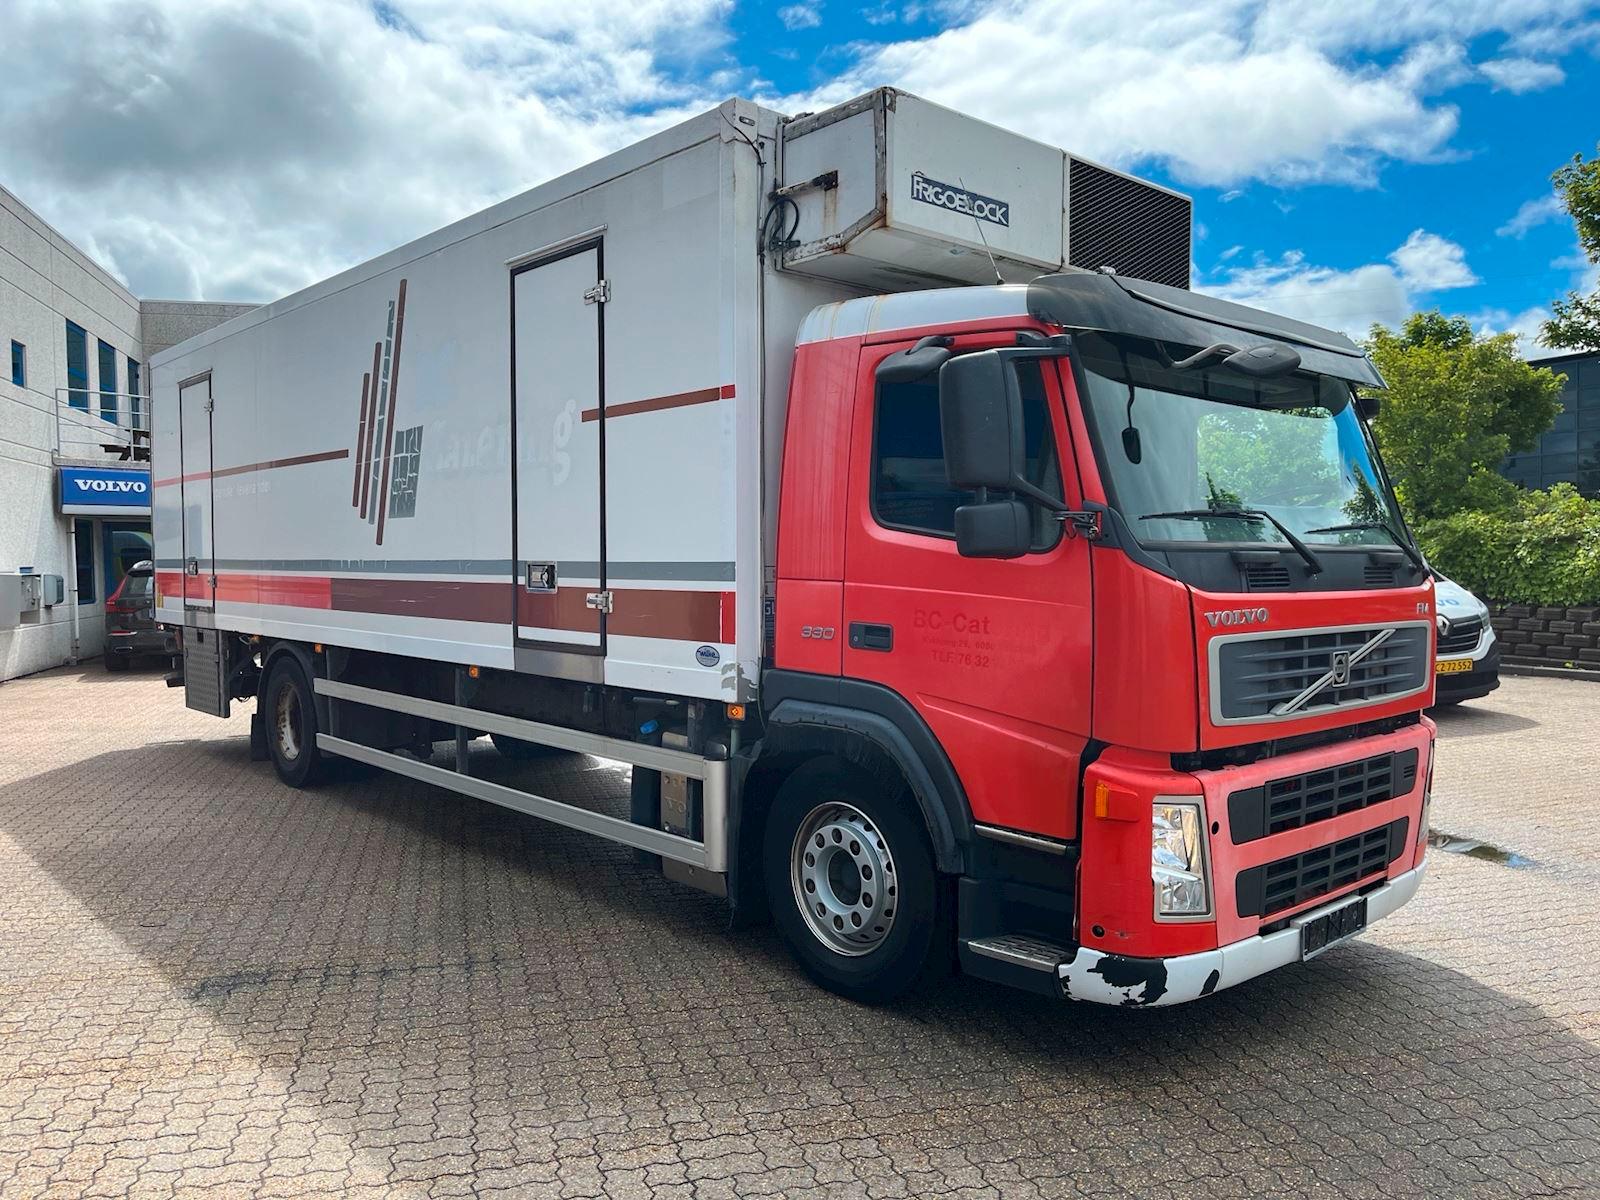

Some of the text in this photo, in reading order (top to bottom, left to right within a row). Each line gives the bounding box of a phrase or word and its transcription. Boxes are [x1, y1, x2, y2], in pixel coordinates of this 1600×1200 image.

[74, 478, 147, 493] VOLVO
[1204, 607, 1269, 627] VOLVO
[800, 625, 835, 640] 330
